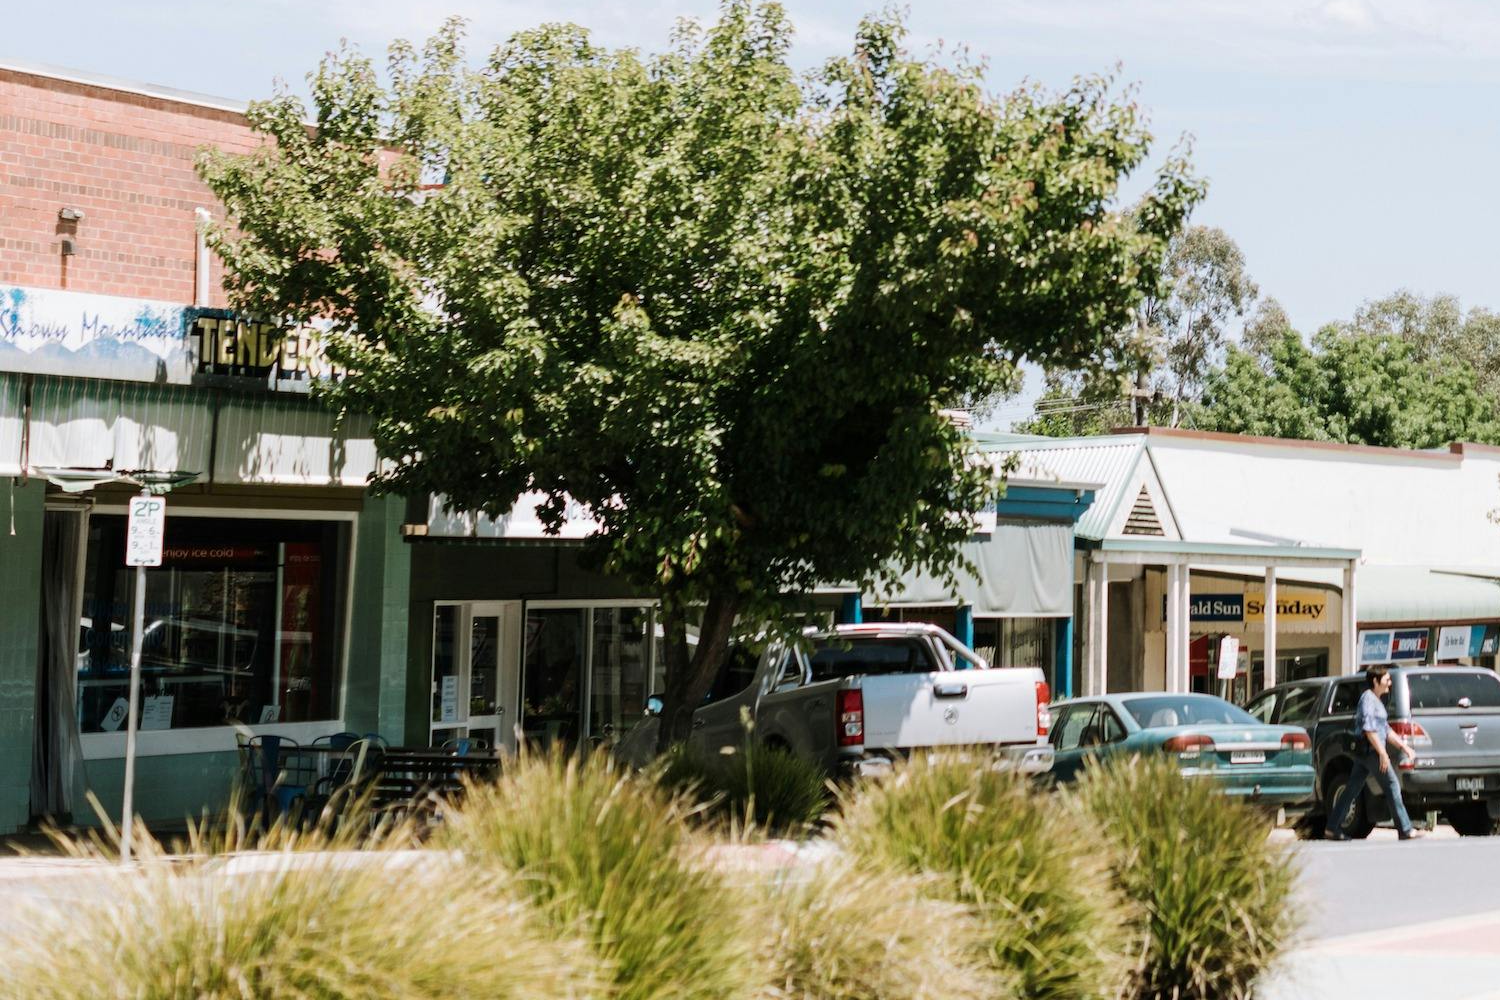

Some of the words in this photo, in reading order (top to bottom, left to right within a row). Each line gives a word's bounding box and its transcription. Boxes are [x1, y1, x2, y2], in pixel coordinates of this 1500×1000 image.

[0, 308, 69, 344] Snowy
[135, 501, 160, 517] 2P
[191, 549, 208, 557] ice
[209, 548, 234, 557] cold
[1213, 600, 1241, 615] Sun
